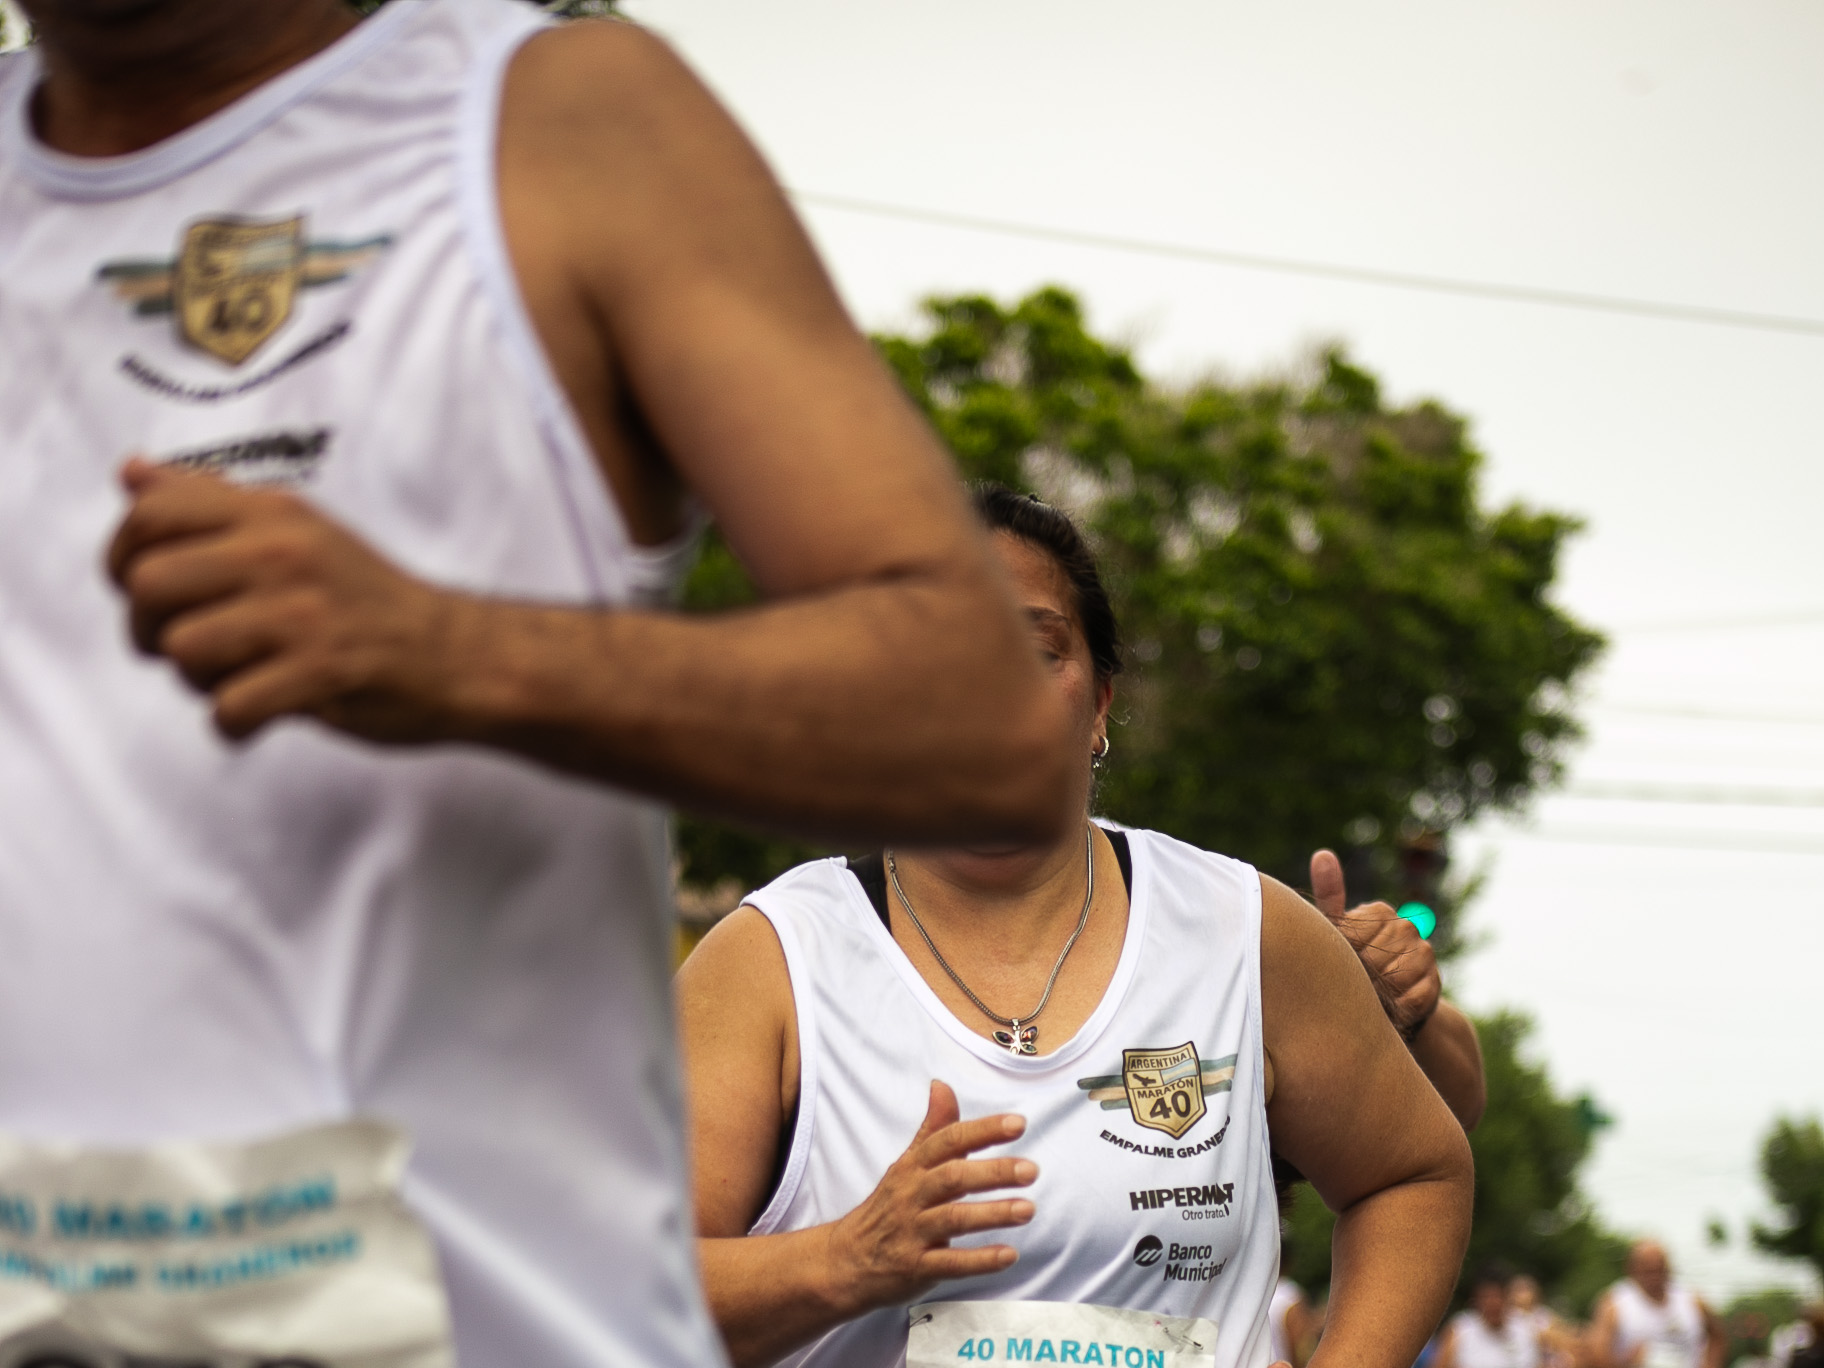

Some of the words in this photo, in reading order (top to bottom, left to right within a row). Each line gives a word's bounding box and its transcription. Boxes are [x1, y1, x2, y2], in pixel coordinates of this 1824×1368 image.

[1130, 1053, 1187, 1069] ARGENTINA
[1149, 1090, 1191, 1119] 40
[1100, 1129, 1175, 1158] EMPALME
[1182, 1209, 1203, 1221] Otro
[1167, 1243, 1212, 1261] Banco
[957, 1337, 995, 1361] 40
